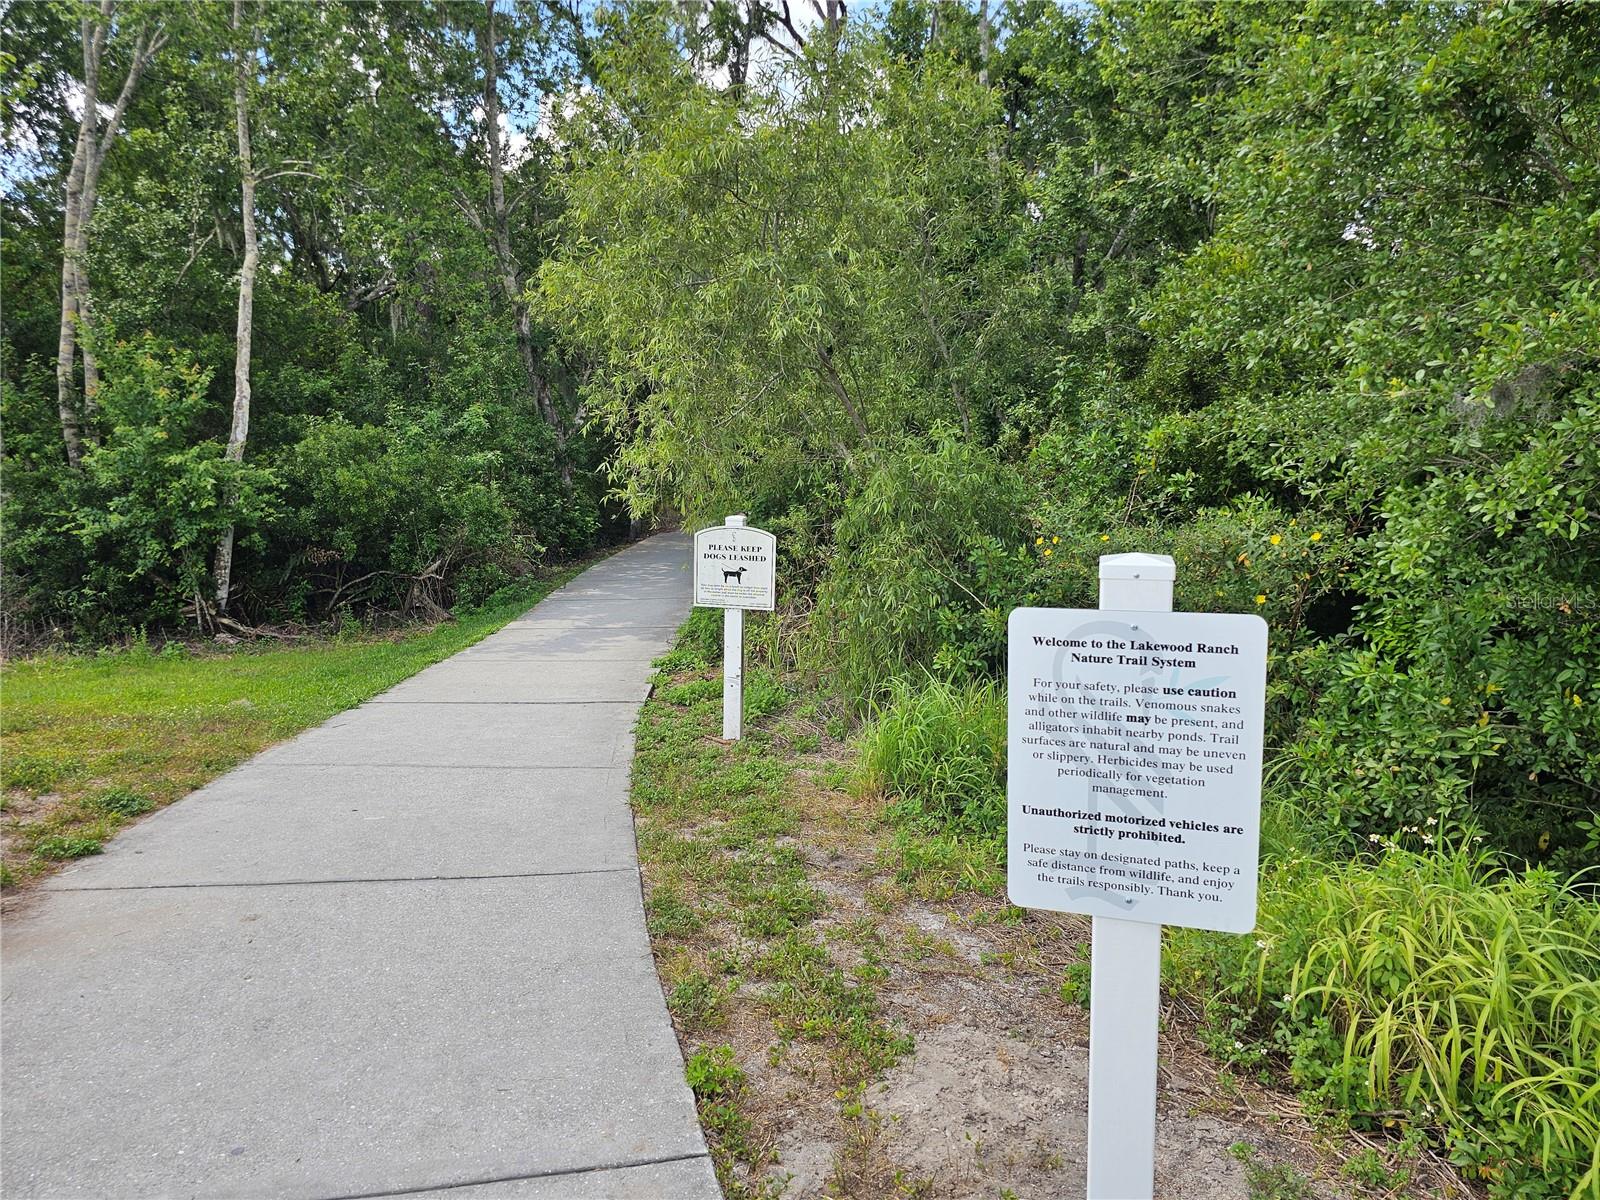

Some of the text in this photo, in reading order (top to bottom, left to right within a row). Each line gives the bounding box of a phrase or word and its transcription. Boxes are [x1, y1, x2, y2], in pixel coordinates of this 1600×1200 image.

[729, 554, 767, 562] LEASHED
[1032, 637, 1239, 655] Welcome to the Lakewood Ranch
[1071, 653, 1196, 668] Nature Trail System
[1033, 678, 1236, 698] For your safety, please use caution
[1028, 693, 1241, 714] while on the trails. Venomous snakes
[1025, 707, 1244, 730] and other wildlife may be present, and
[1028, 722, 1239, 744] alligators inhabit nearby ponds. Trail
[1022, 736, 1246, 760] surfaces are natural and may be uneven
[1032, 751, 1233, 774] or slippery. Herbicides may be used
[1057, 767, 1205, 787] periodically for vegetation
[1092, 784, 1167, 798] management.
[1022, 805, 1244, 835] Unauthorized motorized vehicles are
[1074, 825, 1185, 843] strictly prohibited.
[1023, 843, 1240, 875] Please stay on designated paths, keep a
[1027, 858, 1234, 890] safe distance from wildlife, and enjoy
[1038, 873, 1223, 902] the trails responsibly. Thank you.
